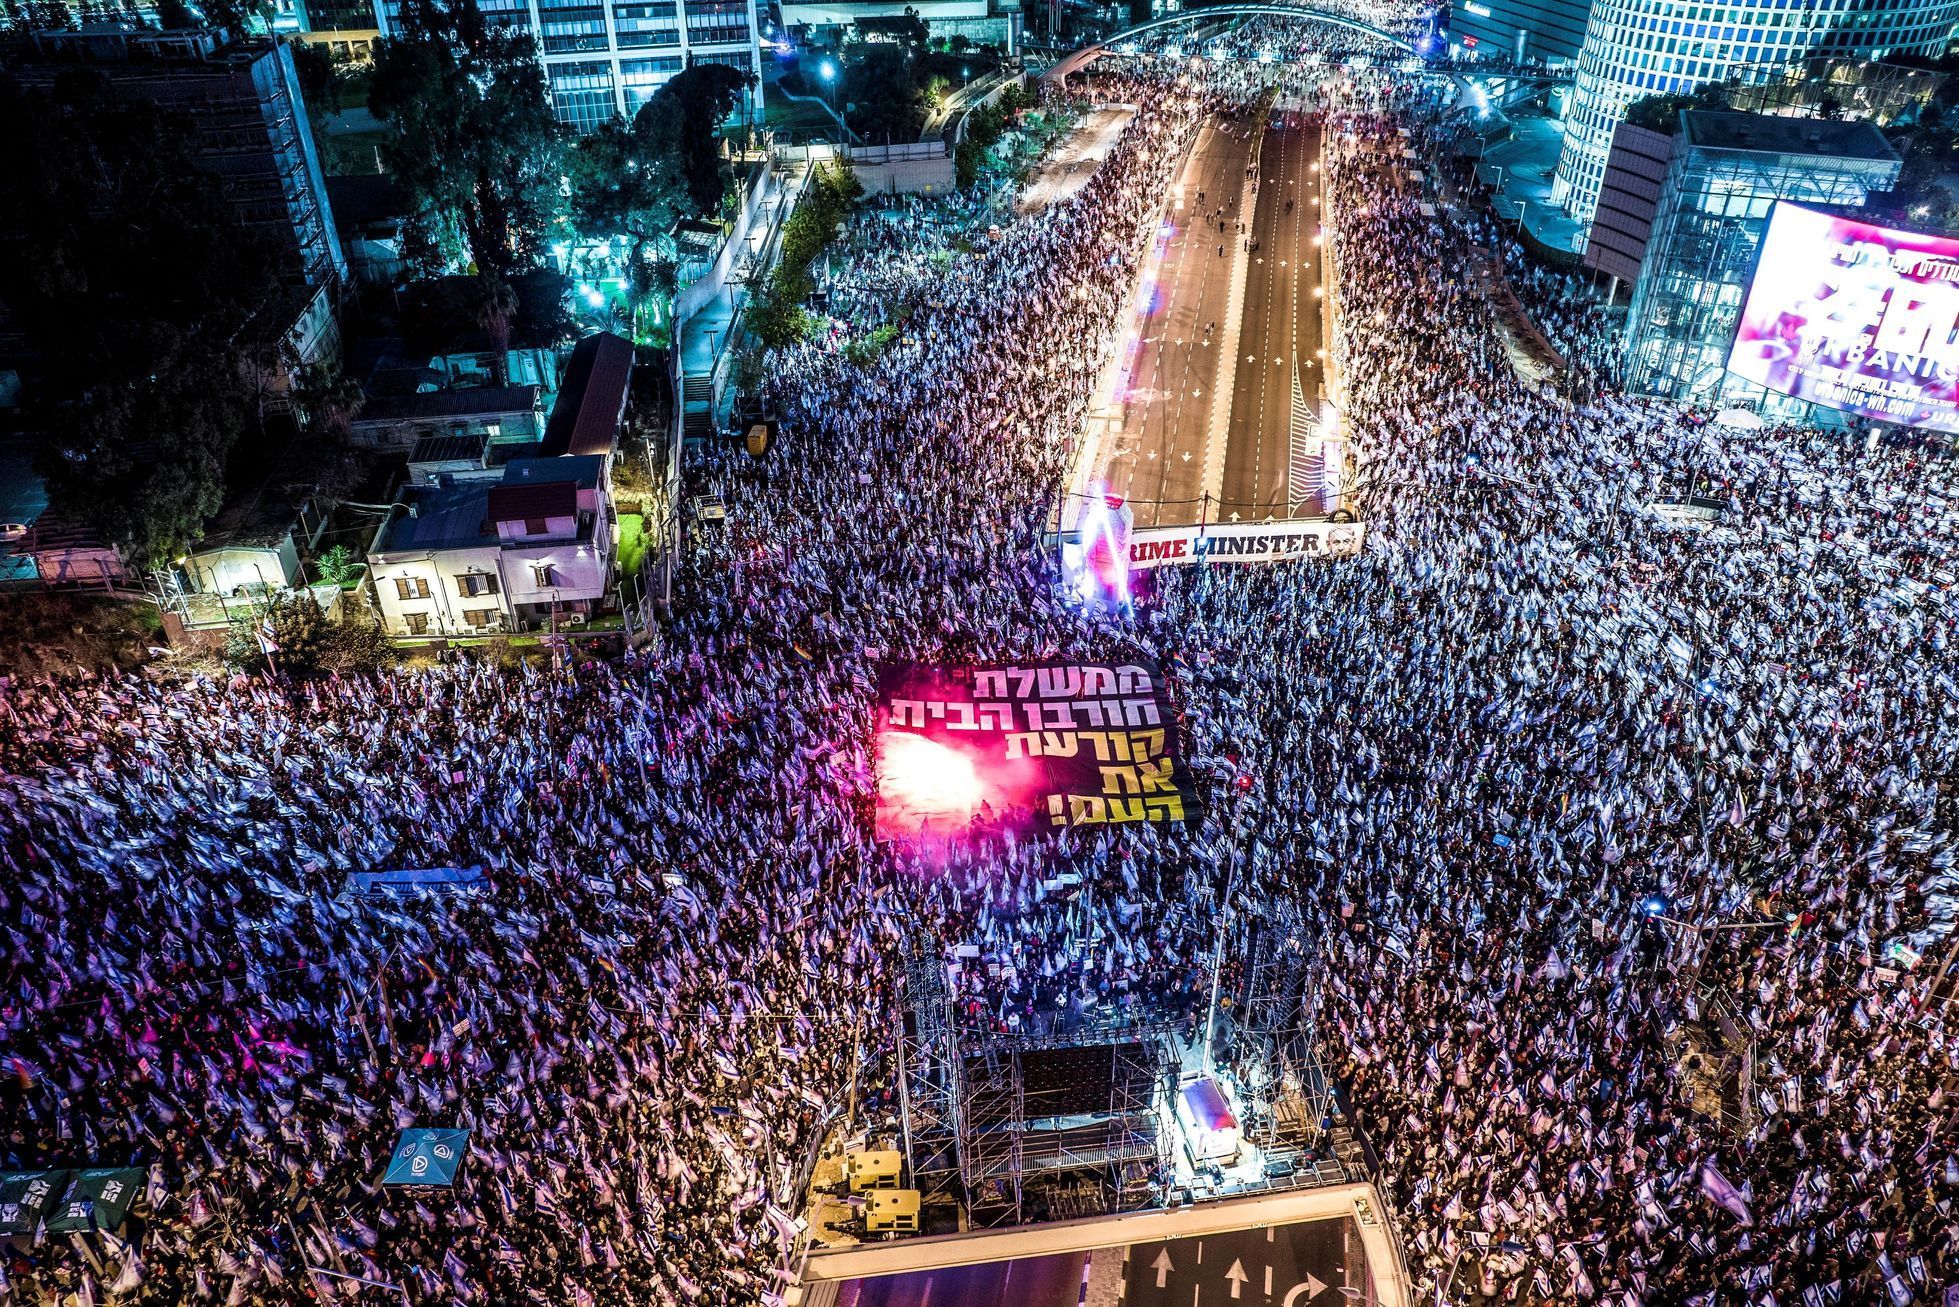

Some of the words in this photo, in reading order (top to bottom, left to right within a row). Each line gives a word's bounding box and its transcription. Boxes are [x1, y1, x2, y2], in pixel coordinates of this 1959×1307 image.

[1130, 538, 1187, 562] RIME
[1192, 533, 1319, 556] MINISTER
[973, 665, 1153, 698] ממשלת
[889, 698, 1015, 731] הבית
[1022, 698, 1161, 731] חורבן
[1004, 727, 1165, 763] קורעת
[1098, 757, 1179, 794] את
[1047, 794, 1185, 826] העם!
